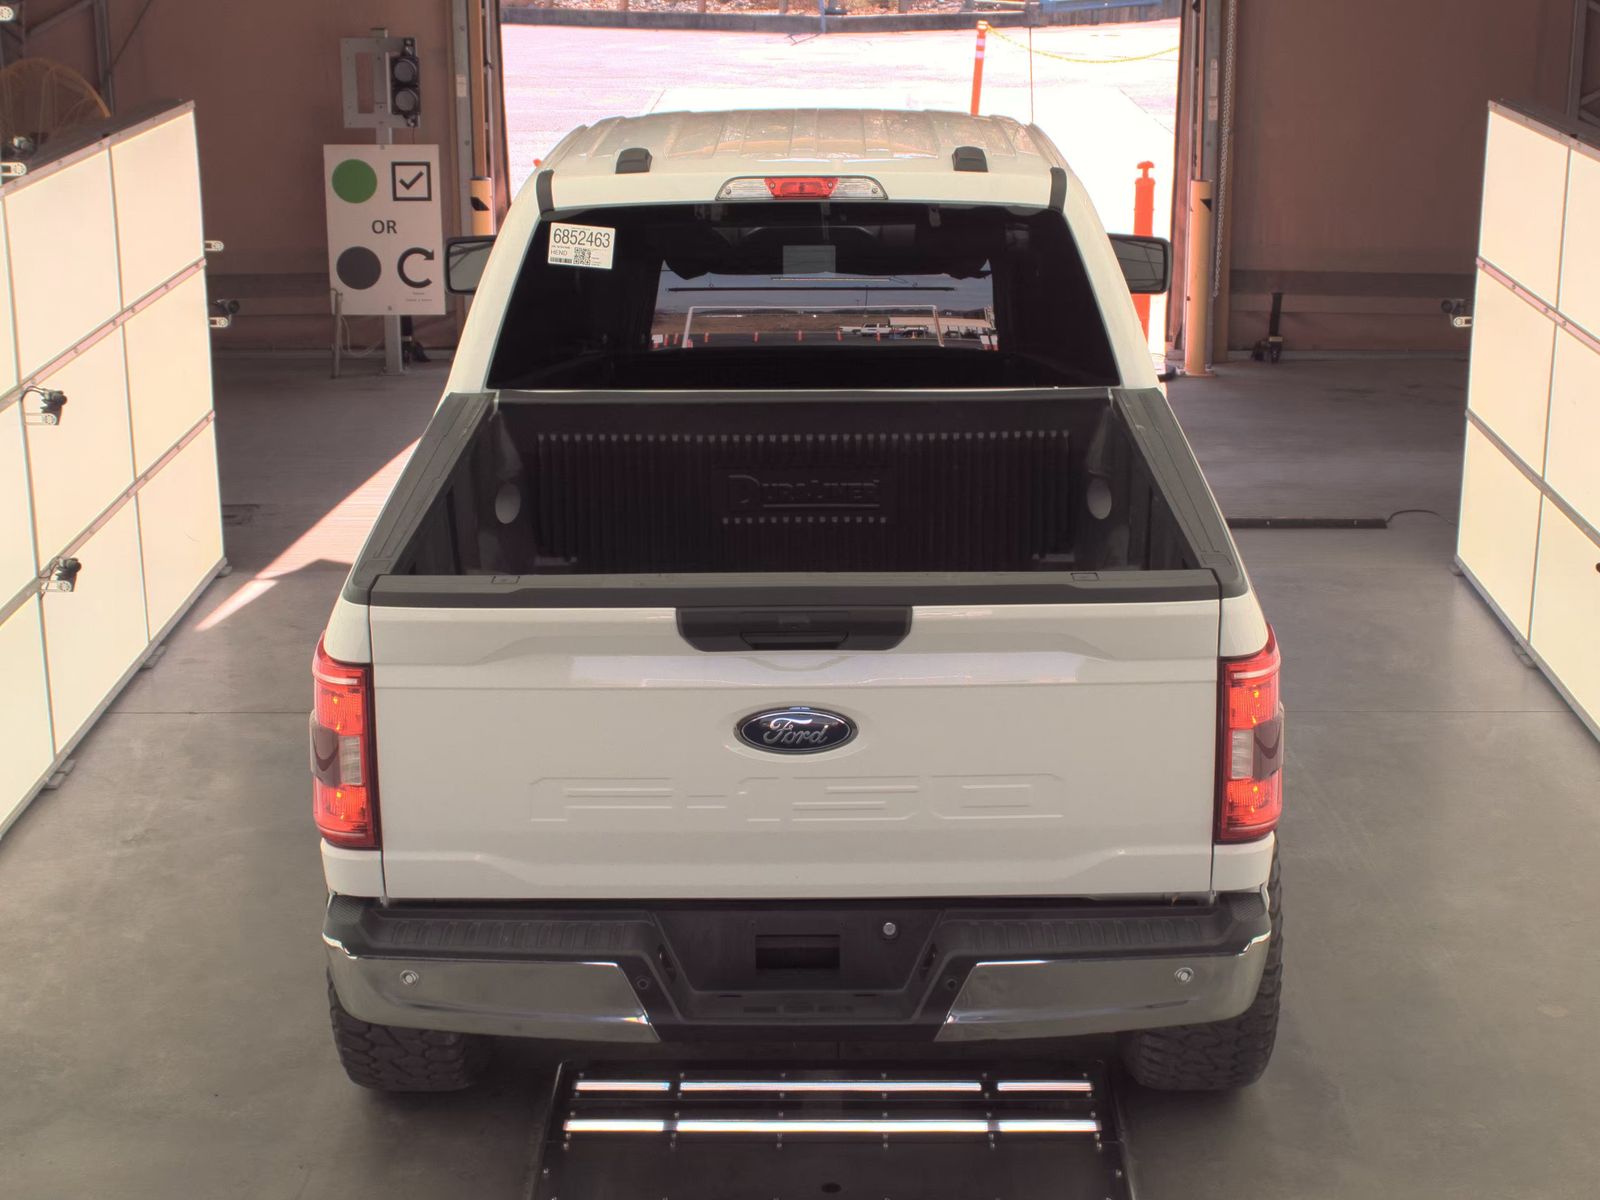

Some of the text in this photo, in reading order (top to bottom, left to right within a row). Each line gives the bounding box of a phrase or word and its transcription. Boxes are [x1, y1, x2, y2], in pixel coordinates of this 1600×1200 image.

[371, 219, 398, 235] OR
[553, 227, 611, 249] 6852463
[762, 717, 829, 744] Ford
[529, 772, 1066, 822] F-150
